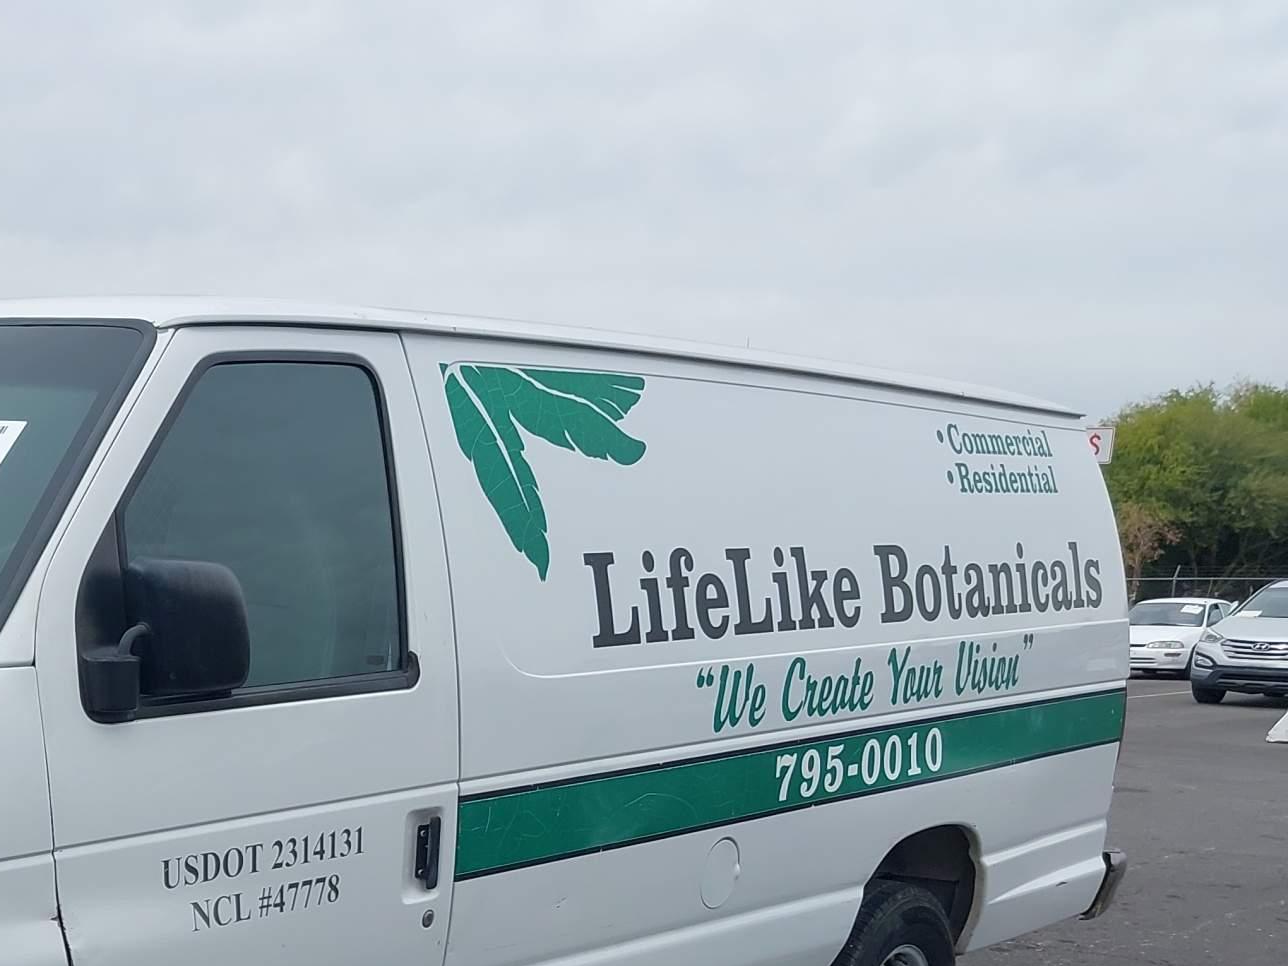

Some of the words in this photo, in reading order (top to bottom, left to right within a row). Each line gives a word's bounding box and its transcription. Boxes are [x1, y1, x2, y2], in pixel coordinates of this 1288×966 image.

[583, 546, 861, 648] LifeLike
[873, 541, 1103, 623] Botanicals
[781, 656, 874, 722] Create
[887, 645, 943, 706] Your
[775, 727, 944, 802] 795-0010
[161, 843, 264, 890] USDOT
[271, 826, 364, 870] 2314131
[190, 892, 252, 932] NCL
[258, 874, 340, 918] #47778
